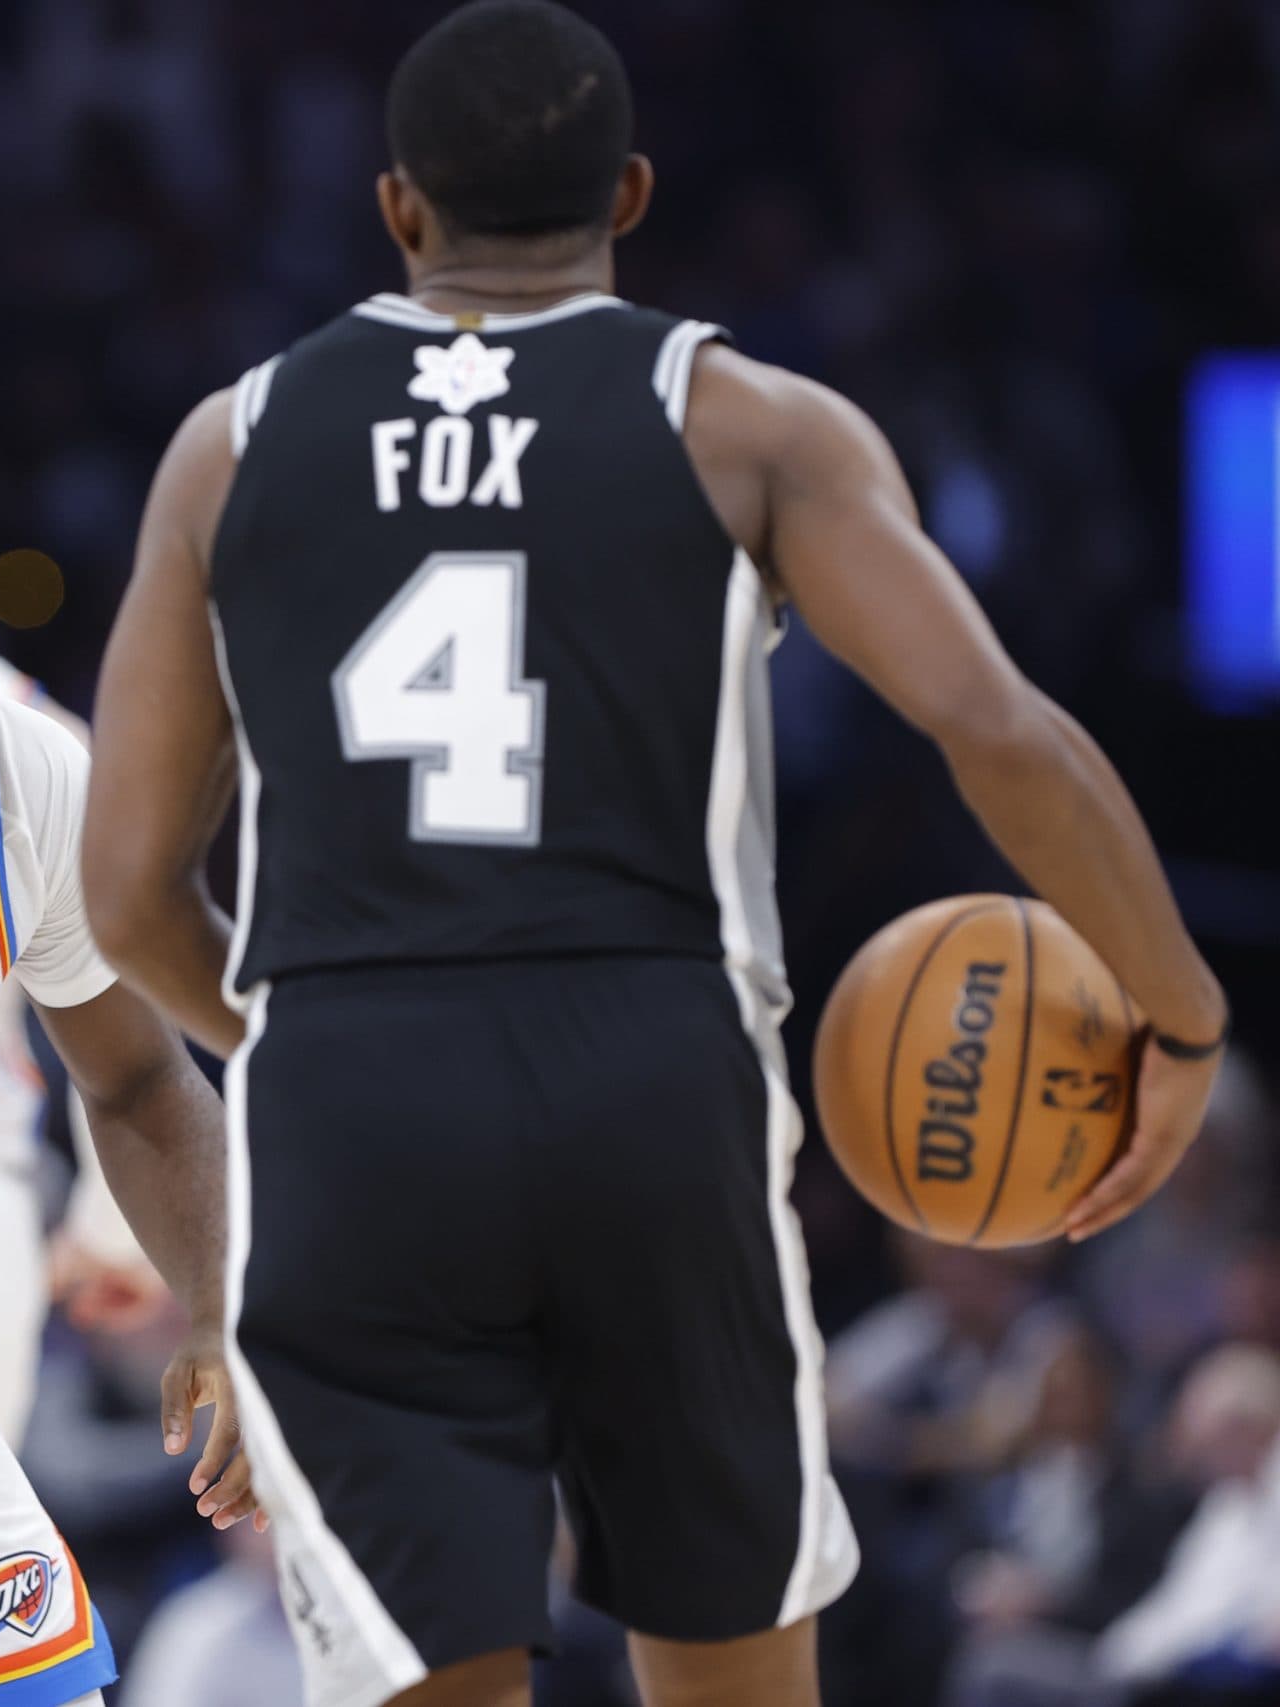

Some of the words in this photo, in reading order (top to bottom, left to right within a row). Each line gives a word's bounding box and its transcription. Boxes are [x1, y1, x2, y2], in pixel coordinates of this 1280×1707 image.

[371, 413, 539, 511] FOX
[330, 550, 546, 847] 4
[919, 962, 1008, 1183] Wilson
